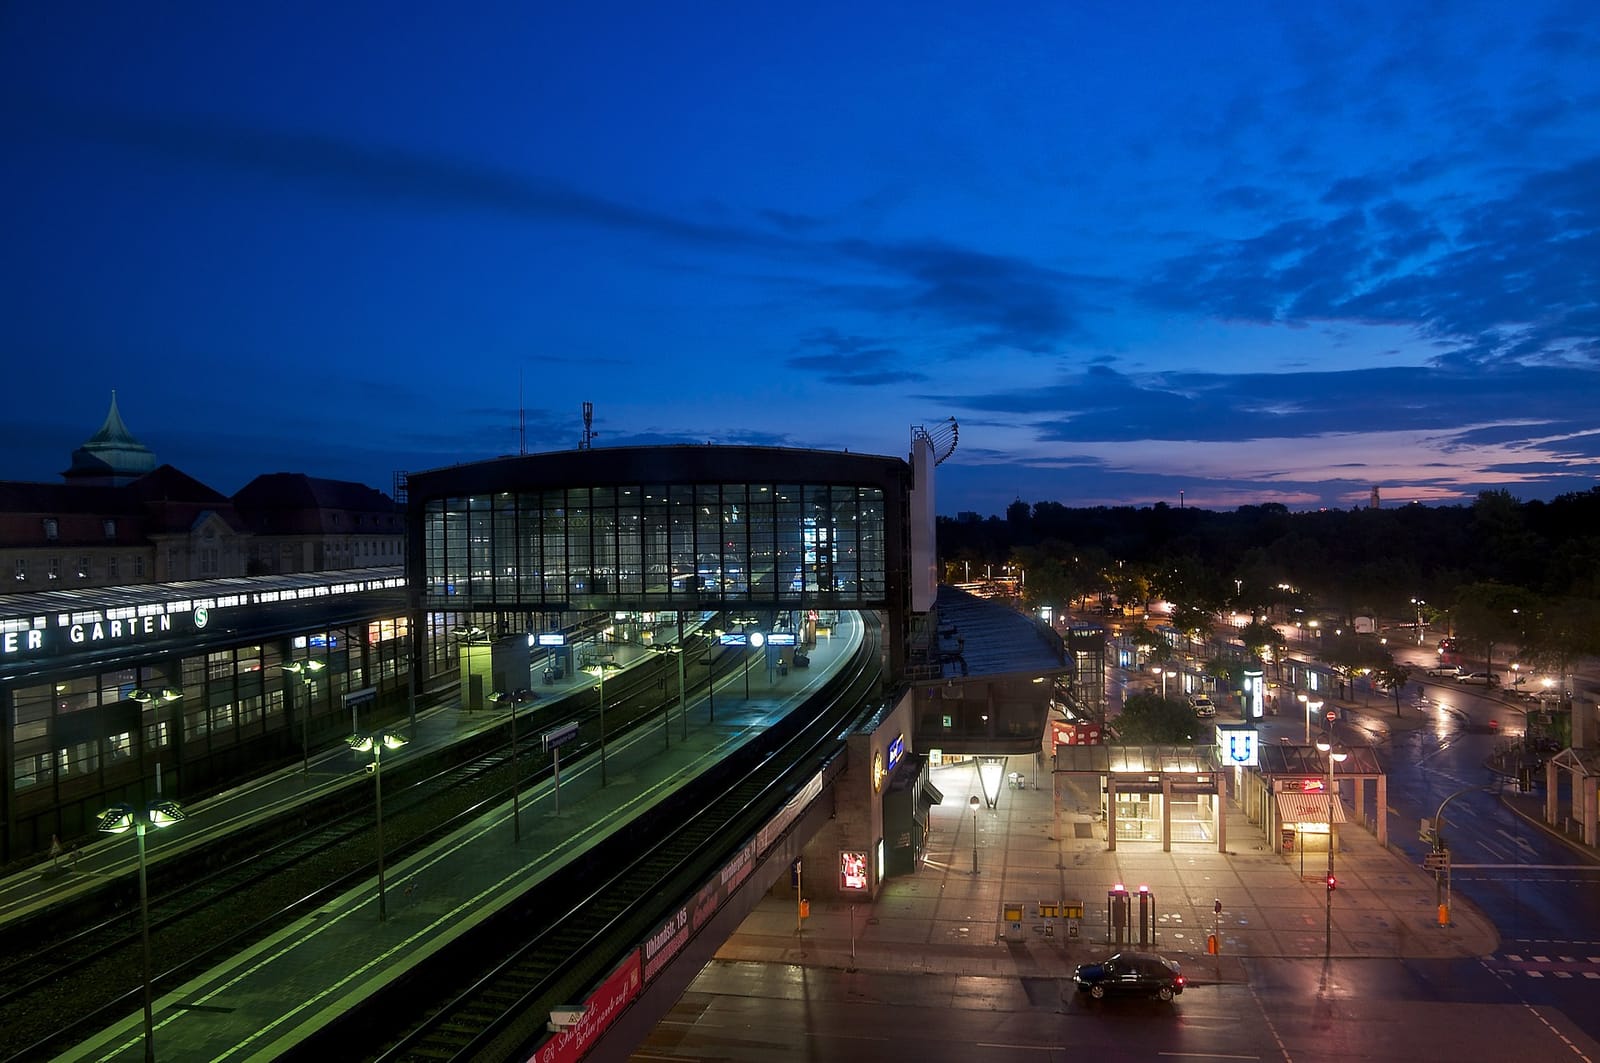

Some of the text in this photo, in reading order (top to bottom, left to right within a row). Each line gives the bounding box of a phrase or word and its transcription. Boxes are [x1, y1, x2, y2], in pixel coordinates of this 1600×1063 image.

[196, 607, 207, 626] S
[4, 614, 171, 653] ER GARTEN
[1230, 736, 1251, 761] U
